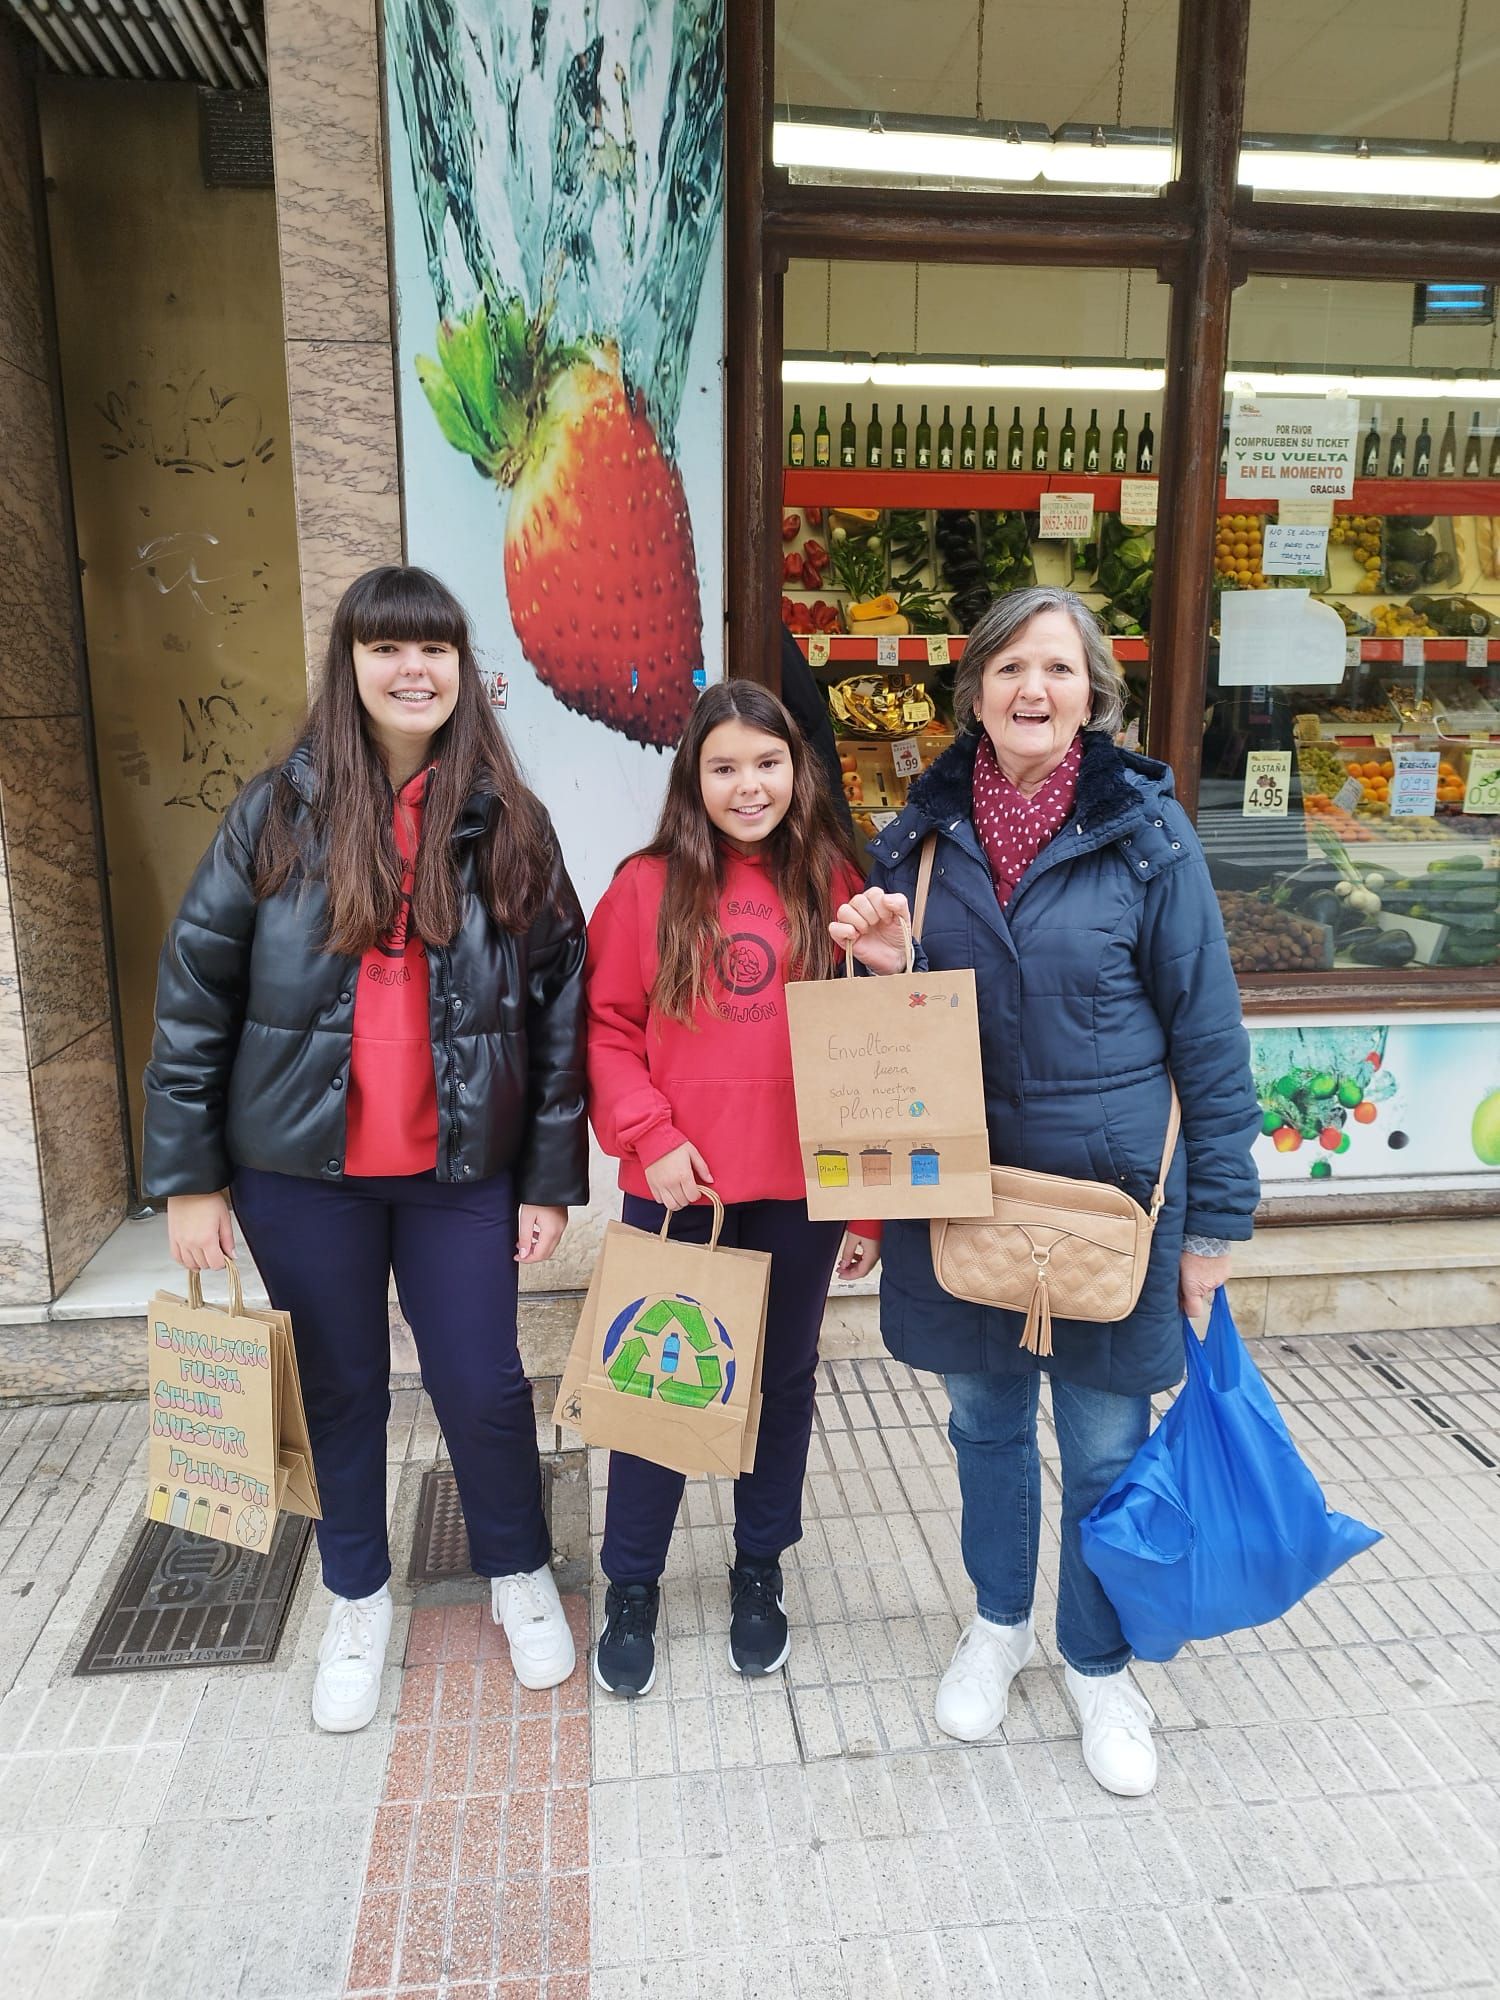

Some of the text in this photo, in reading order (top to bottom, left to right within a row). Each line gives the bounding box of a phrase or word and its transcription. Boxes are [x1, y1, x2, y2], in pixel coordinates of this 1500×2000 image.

[1276, 425, 1312, 434] POR FAVOR
[1234, 437, 1350, 448] COMPRUEBEN SU TICKET
[1235, 452, 1348, 462] Y SU VUELTA
[1240, 465, 1343, 479] EN EL MOMENTO
[1310, 485, 1346, 494] GRACIAS
[1269, 528, 1282, 536] NO
[1287, 528, 1296, 536] SE
[879, 651, 897, 660] 1.49
[896, 758, 918, 772] 1.99
[1251, 763, 1287, 772] CASTAÑA
[1248, 788, 1284, 807] 4.95
[1469, 786, 1500, 806] 0.9
[727, 901, 773, 920] SAN
[717, 1001, 778, 1023] GIJÓN
[828, 1032, 911, 1061] Envoltorios
[873, 1064, 909, 1080] fuera
[829, 1085, 917, 1099] salva nuestro
[168, 1444, 270, 1508] PLANETA
